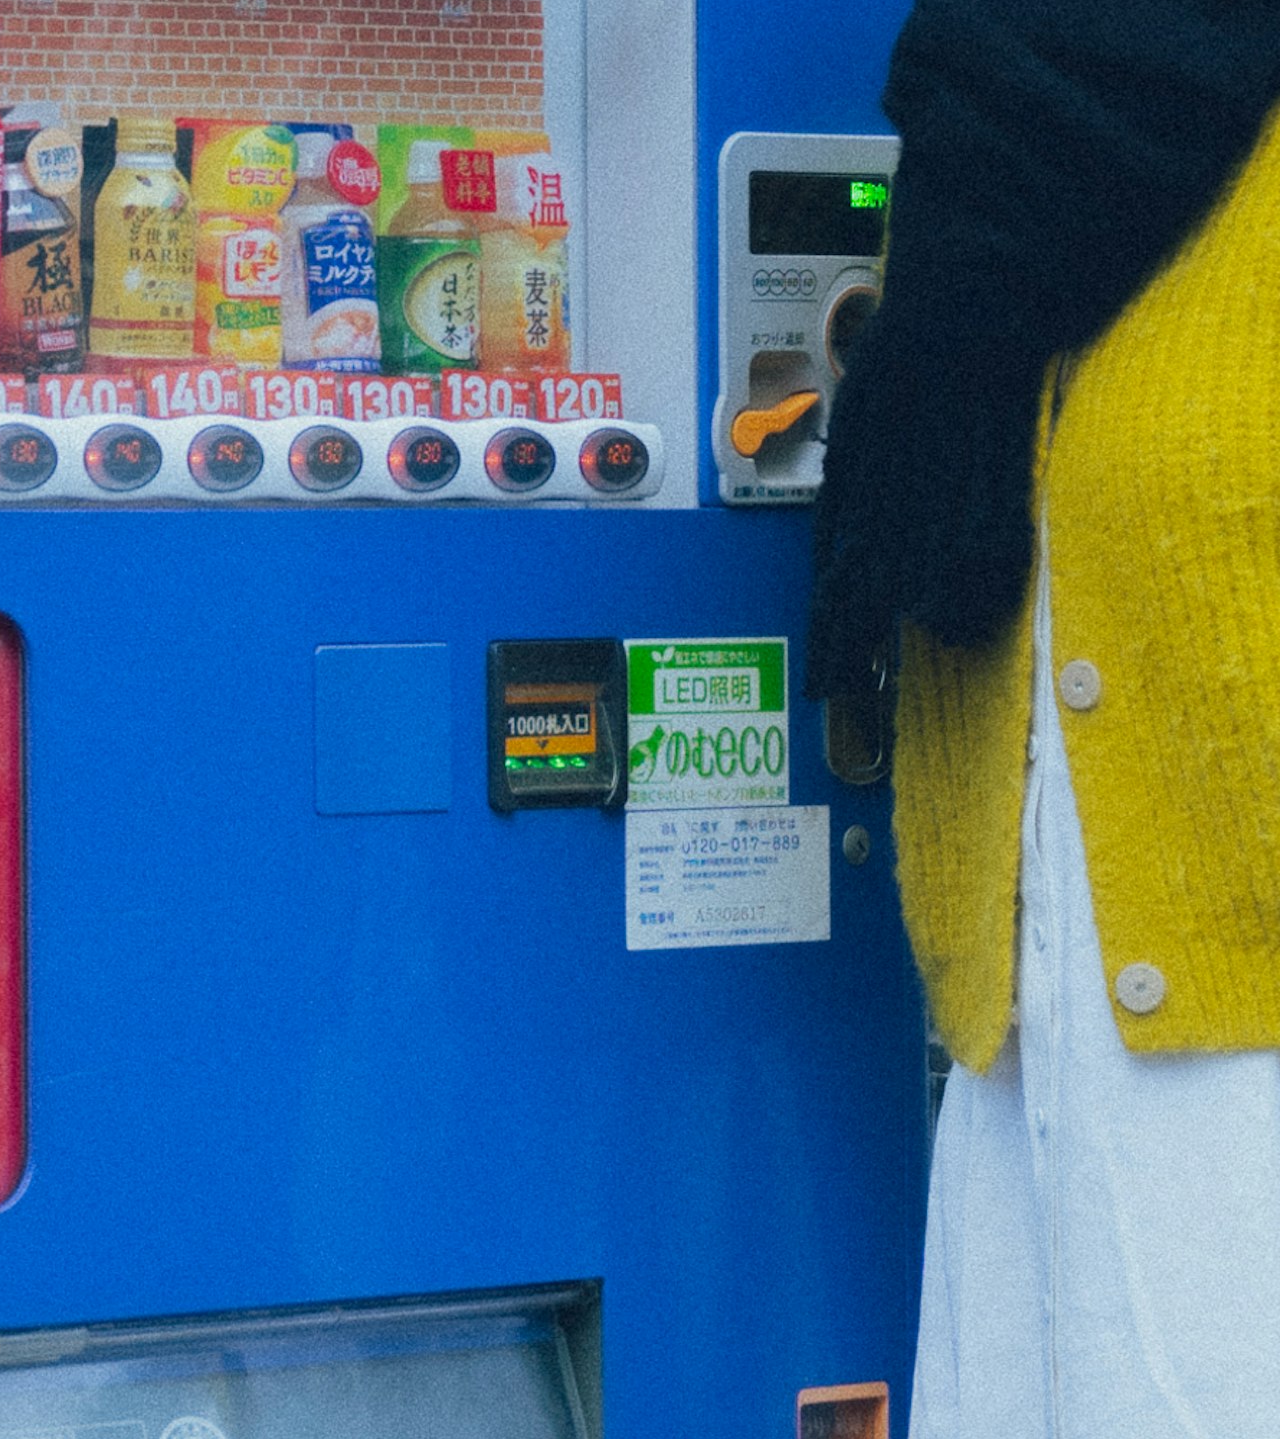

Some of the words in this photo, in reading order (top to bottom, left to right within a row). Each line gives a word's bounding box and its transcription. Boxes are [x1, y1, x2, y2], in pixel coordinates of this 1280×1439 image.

[525, 164, 569, 228] 温
[25, 241, 74, 294] 極
[234, 262, 282, 283] レモン
[439, 273, 462, 349] 日本茶
[525, 268, 549, 347] 麦茶
[150, 369, 239, 419] 140円
[249, 375, 334, 419] 130円
[540, 377, 619, 420] 120円
[662, 673, 752, 706] LED照明
[507, 712, 590, 737] 1000札入口
[666, 724, 785, 779] のむeco
